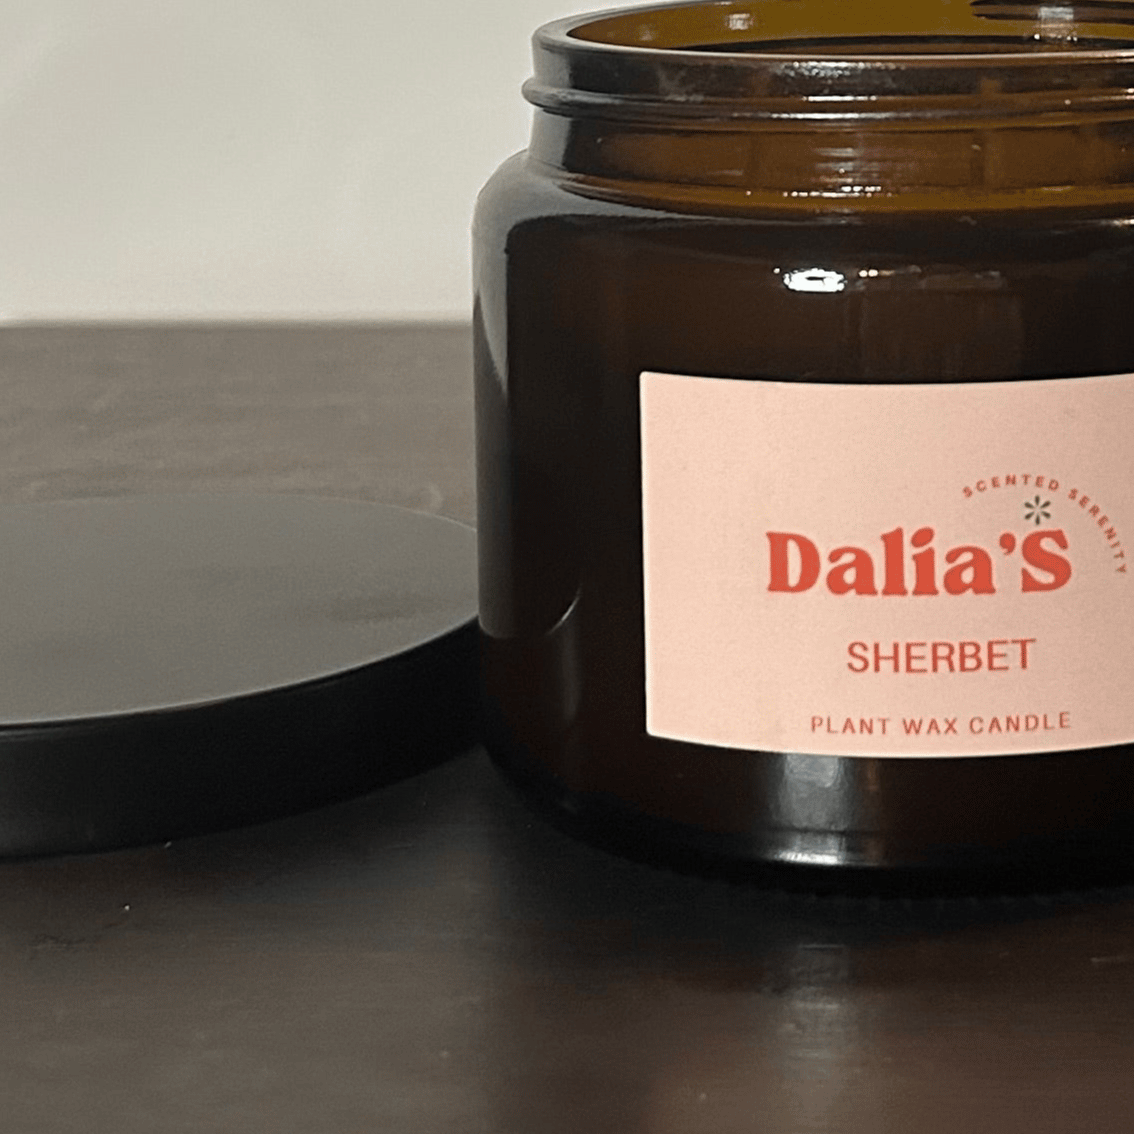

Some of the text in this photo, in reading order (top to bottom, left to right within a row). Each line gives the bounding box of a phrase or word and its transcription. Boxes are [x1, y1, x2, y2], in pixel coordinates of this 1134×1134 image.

[962, 473, 1128, 574] SCENTED SERENITY
[846, 638, 1037, 674] SHERBET
[810, 711, 1070, 735] PLANT WAX CANDLE
